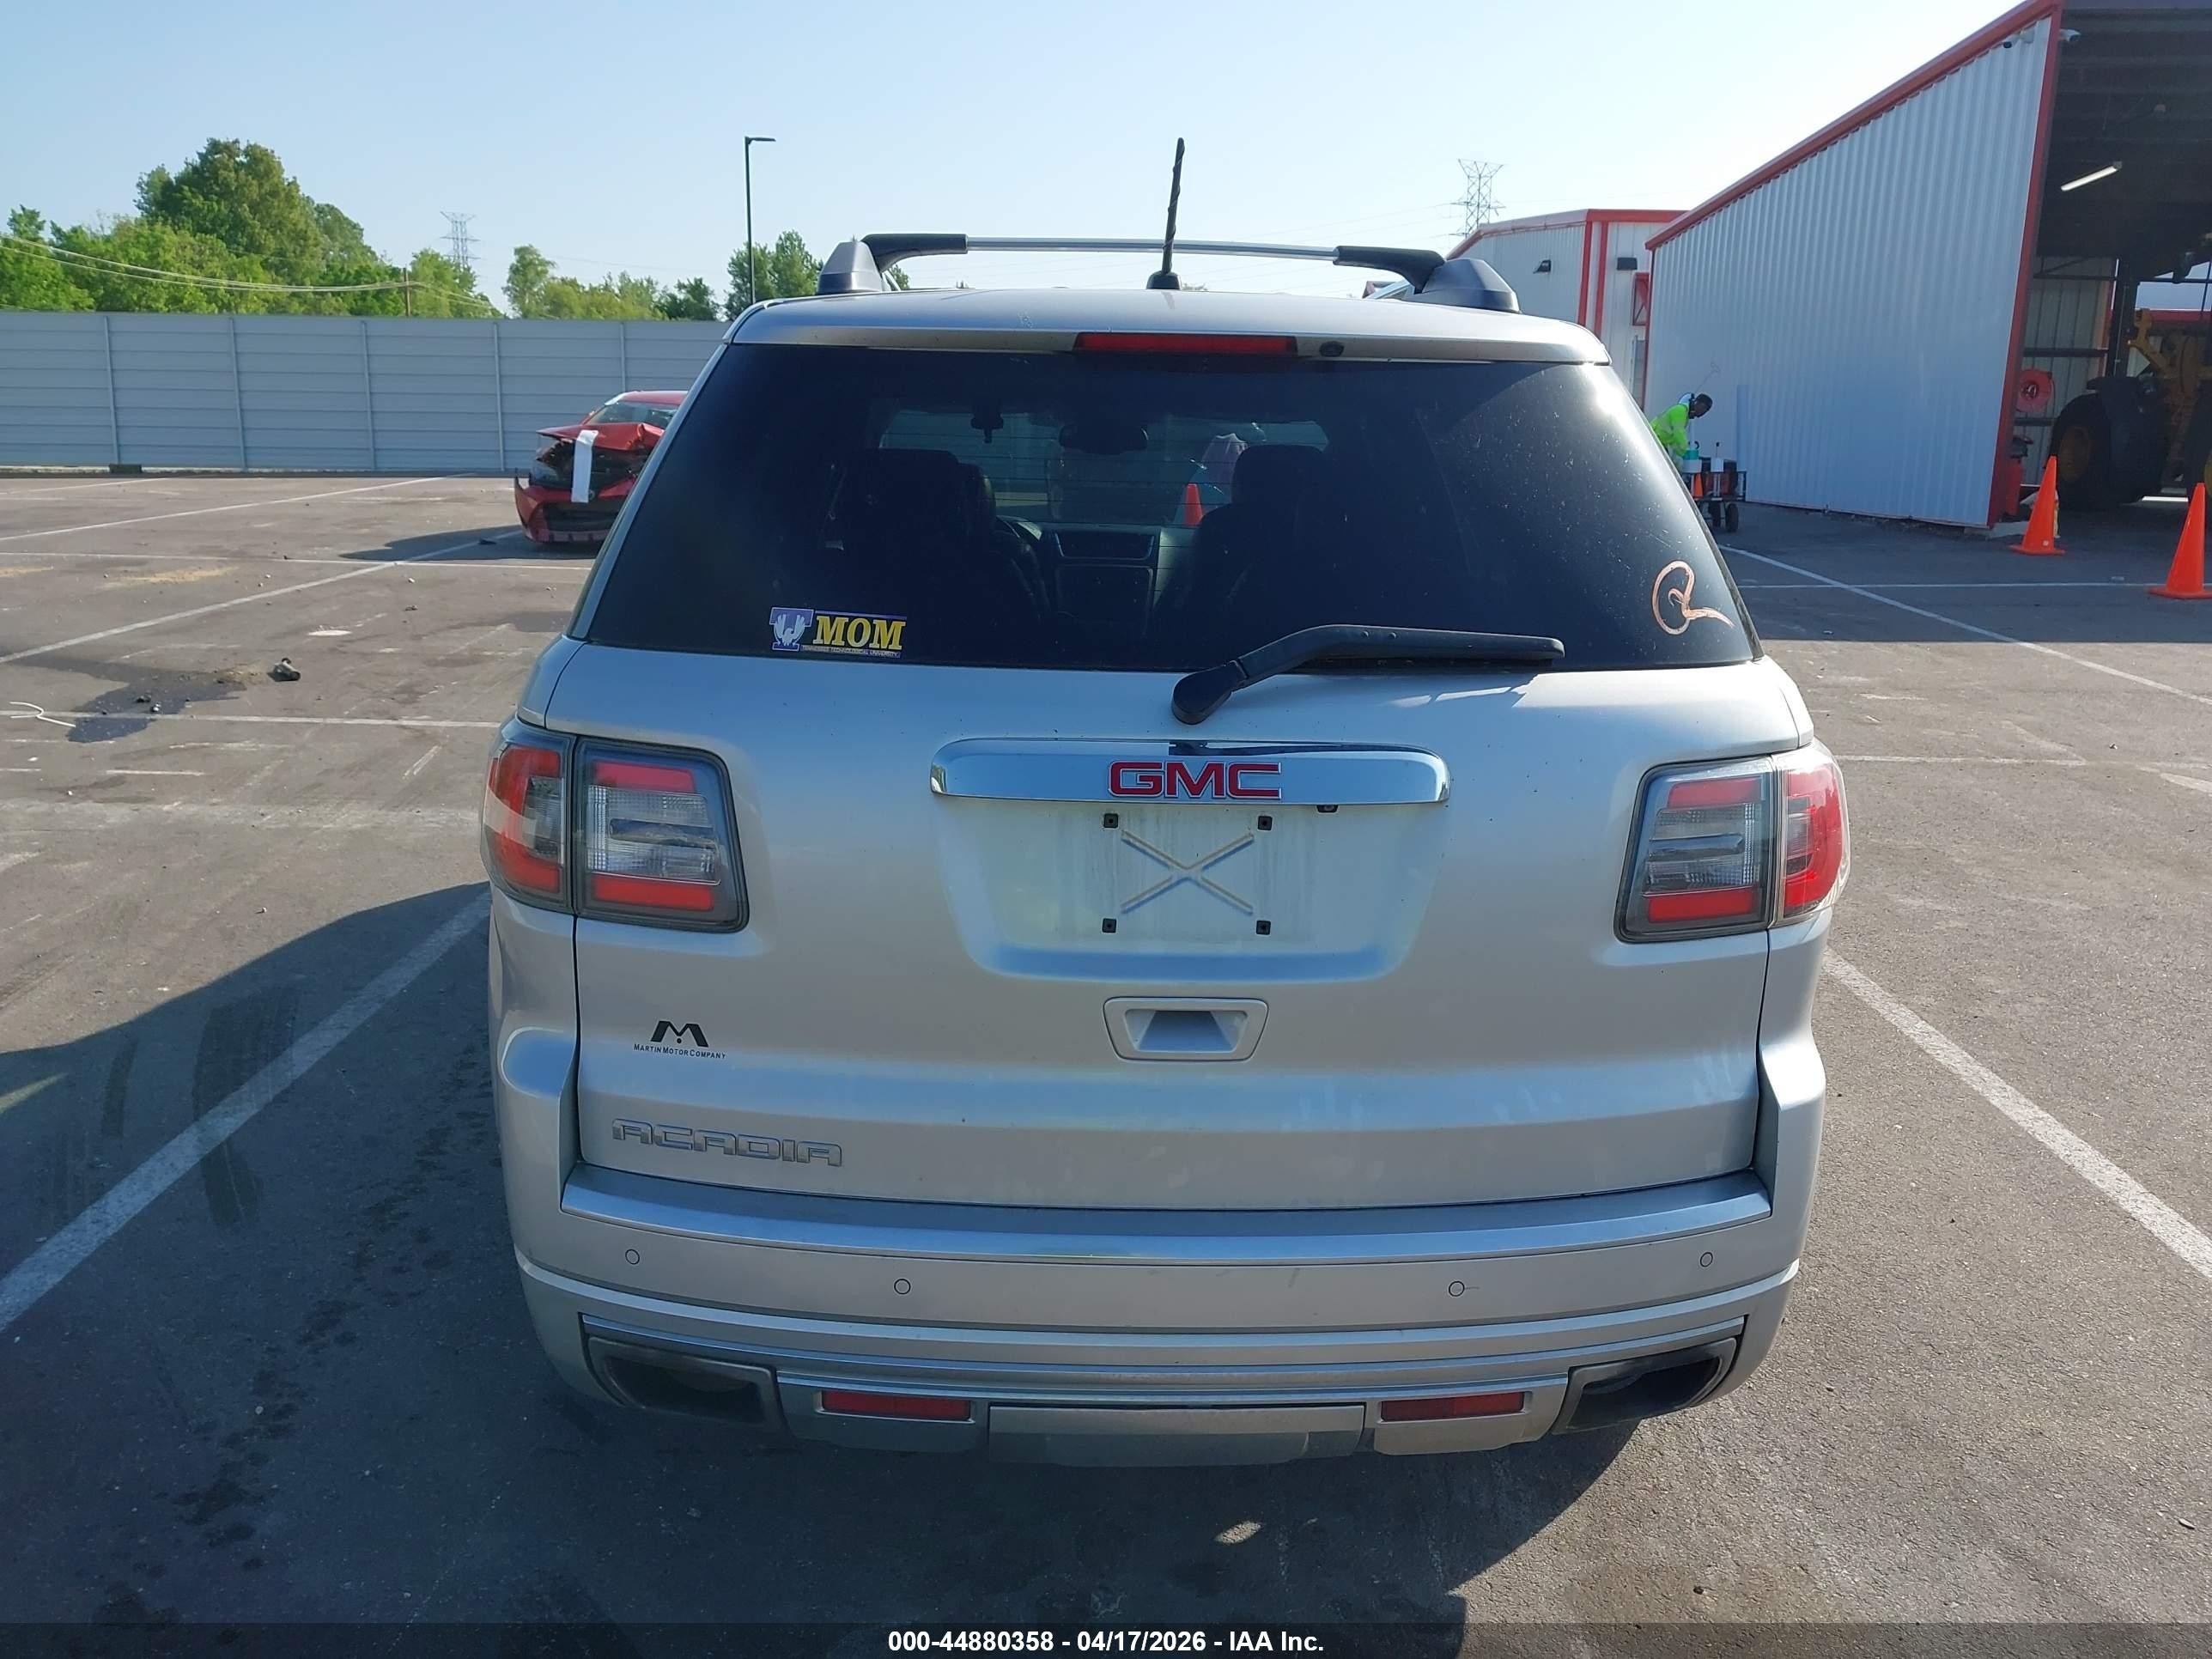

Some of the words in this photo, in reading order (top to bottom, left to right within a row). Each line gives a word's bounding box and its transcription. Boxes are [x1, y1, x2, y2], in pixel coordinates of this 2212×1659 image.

[812, 615, 907, 651] MOM
[1108, 761, 1282, 799] GMC
[633, 1043, 662, 1054] MARTIN
[662, 1046, 689, 1056] MOTOR
[690, 1049, 726, 1060] COMPANY
[611, 1117, 843, 1167] ACADIA
